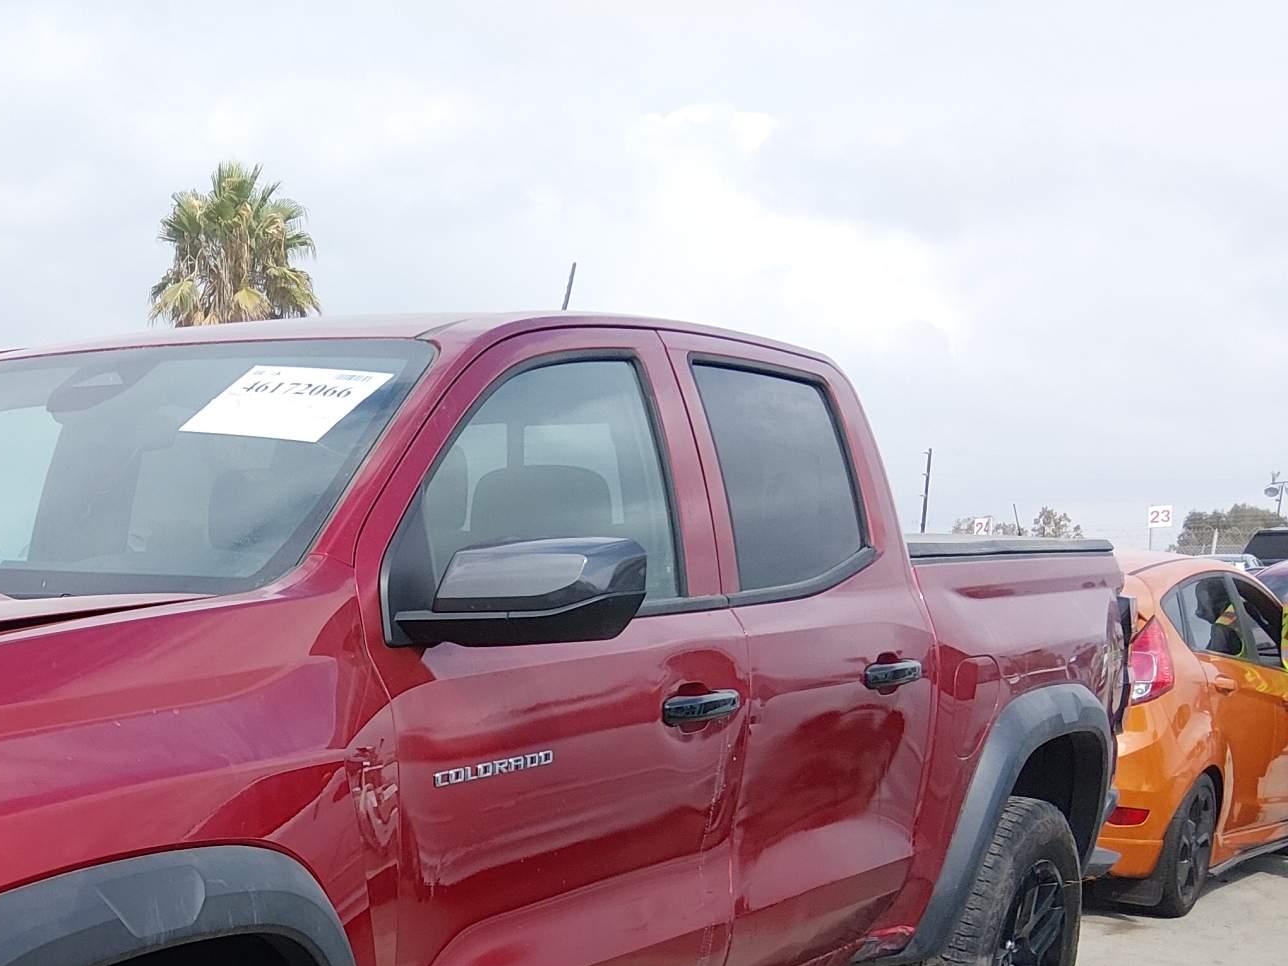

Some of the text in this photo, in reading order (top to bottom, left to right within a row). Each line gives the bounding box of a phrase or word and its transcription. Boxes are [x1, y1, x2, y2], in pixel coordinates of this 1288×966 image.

[242, 380, 353, 399] 46172066
[1150, 509, 1171, 523] 23
[975, 518, 991, 535] 24
[433, 749, 554, 788] COLORADO
